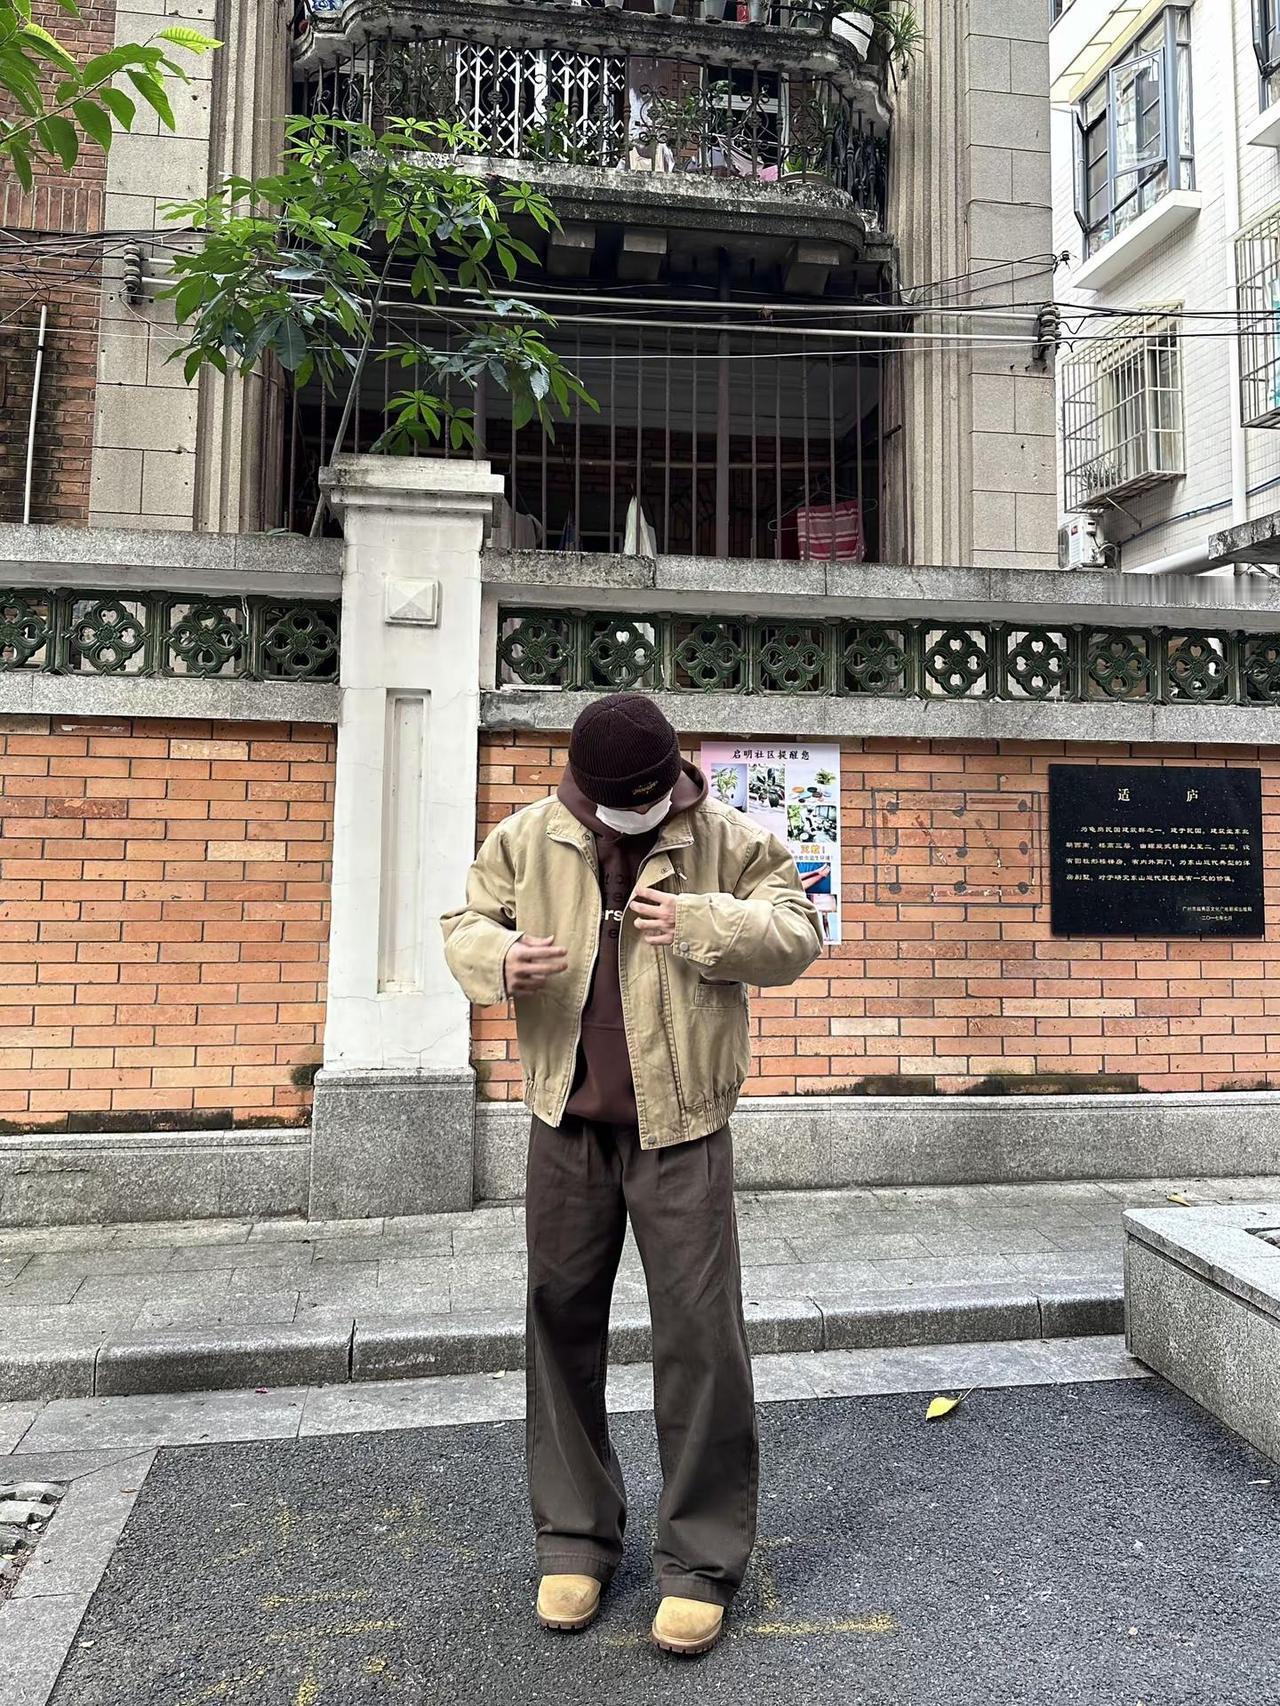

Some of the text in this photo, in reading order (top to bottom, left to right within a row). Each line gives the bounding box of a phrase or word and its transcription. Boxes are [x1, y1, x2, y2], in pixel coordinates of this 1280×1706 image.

[733, 749, 810, 761] 启明社区提醒您
[602, 909, 623, 922] rs
